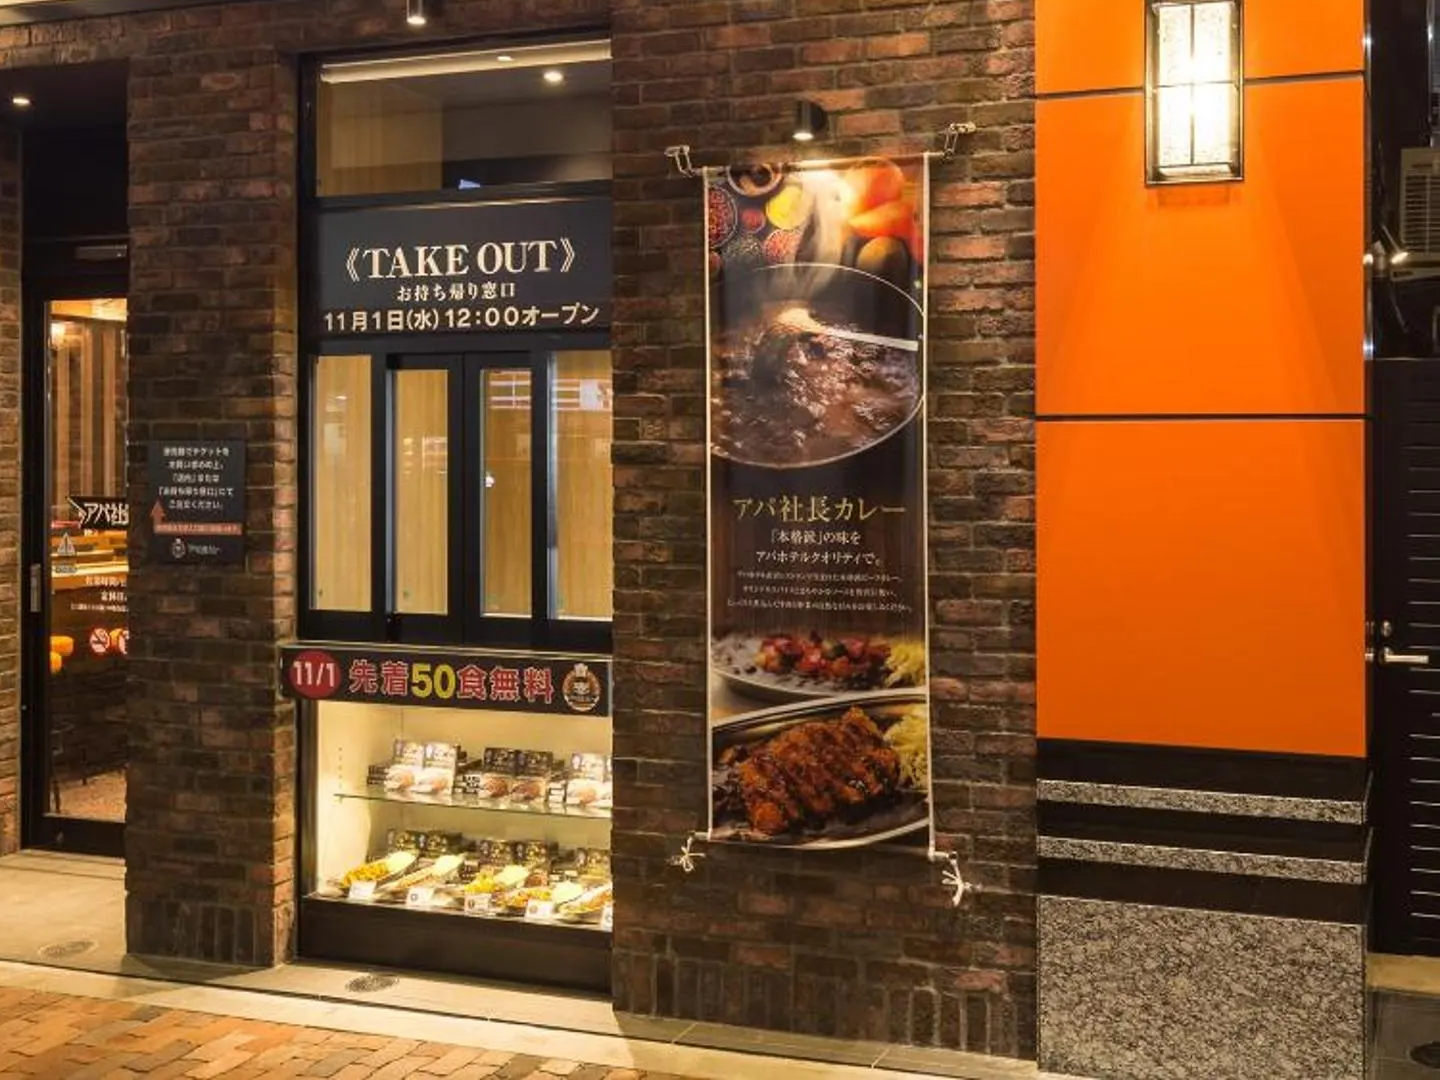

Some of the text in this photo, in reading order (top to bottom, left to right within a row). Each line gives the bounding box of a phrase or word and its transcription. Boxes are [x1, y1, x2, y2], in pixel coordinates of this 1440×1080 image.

[397, 281, 516, 302] お持ち帰り窓口
[732, 494, 906, 523] アパ社長カレー
[771, 529, 861, 546] 「本格派」の味を
[756, 550, 883, 567] アパホテルクオリティで。
[292, 658, 554, 705] 11/1 先着50食無料
